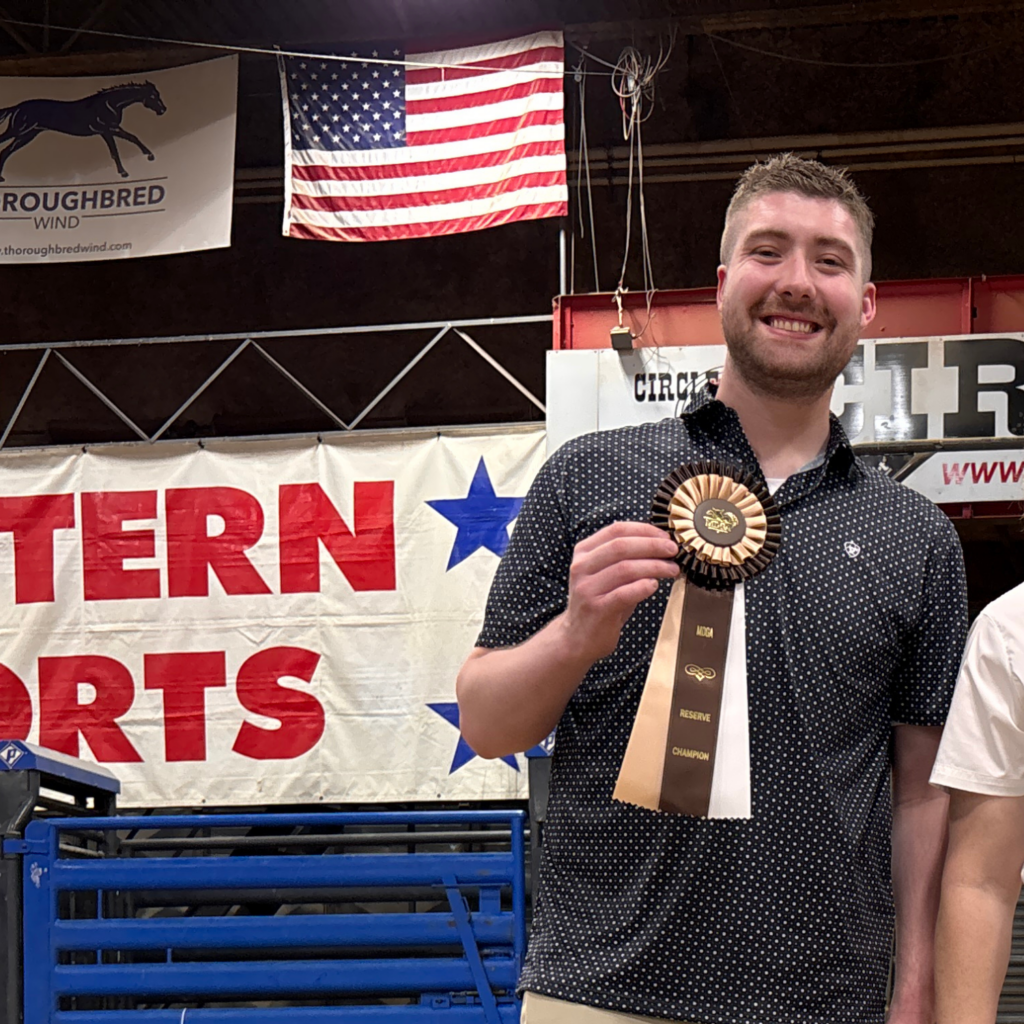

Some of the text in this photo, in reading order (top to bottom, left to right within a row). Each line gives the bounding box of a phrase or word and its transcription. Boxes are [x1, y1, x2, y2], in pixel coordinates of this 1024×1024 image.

[2, 185, 165, 212] ROUGHBRED
[34, 216, 80, 230] WIND
[0, 241, 132, 257] .thoroughbredwind.com
[0, 645, 326, 763] RTS
[680, 708, 711, 722] RESERVE
[672, 746, 710, 761] CHAMPION
